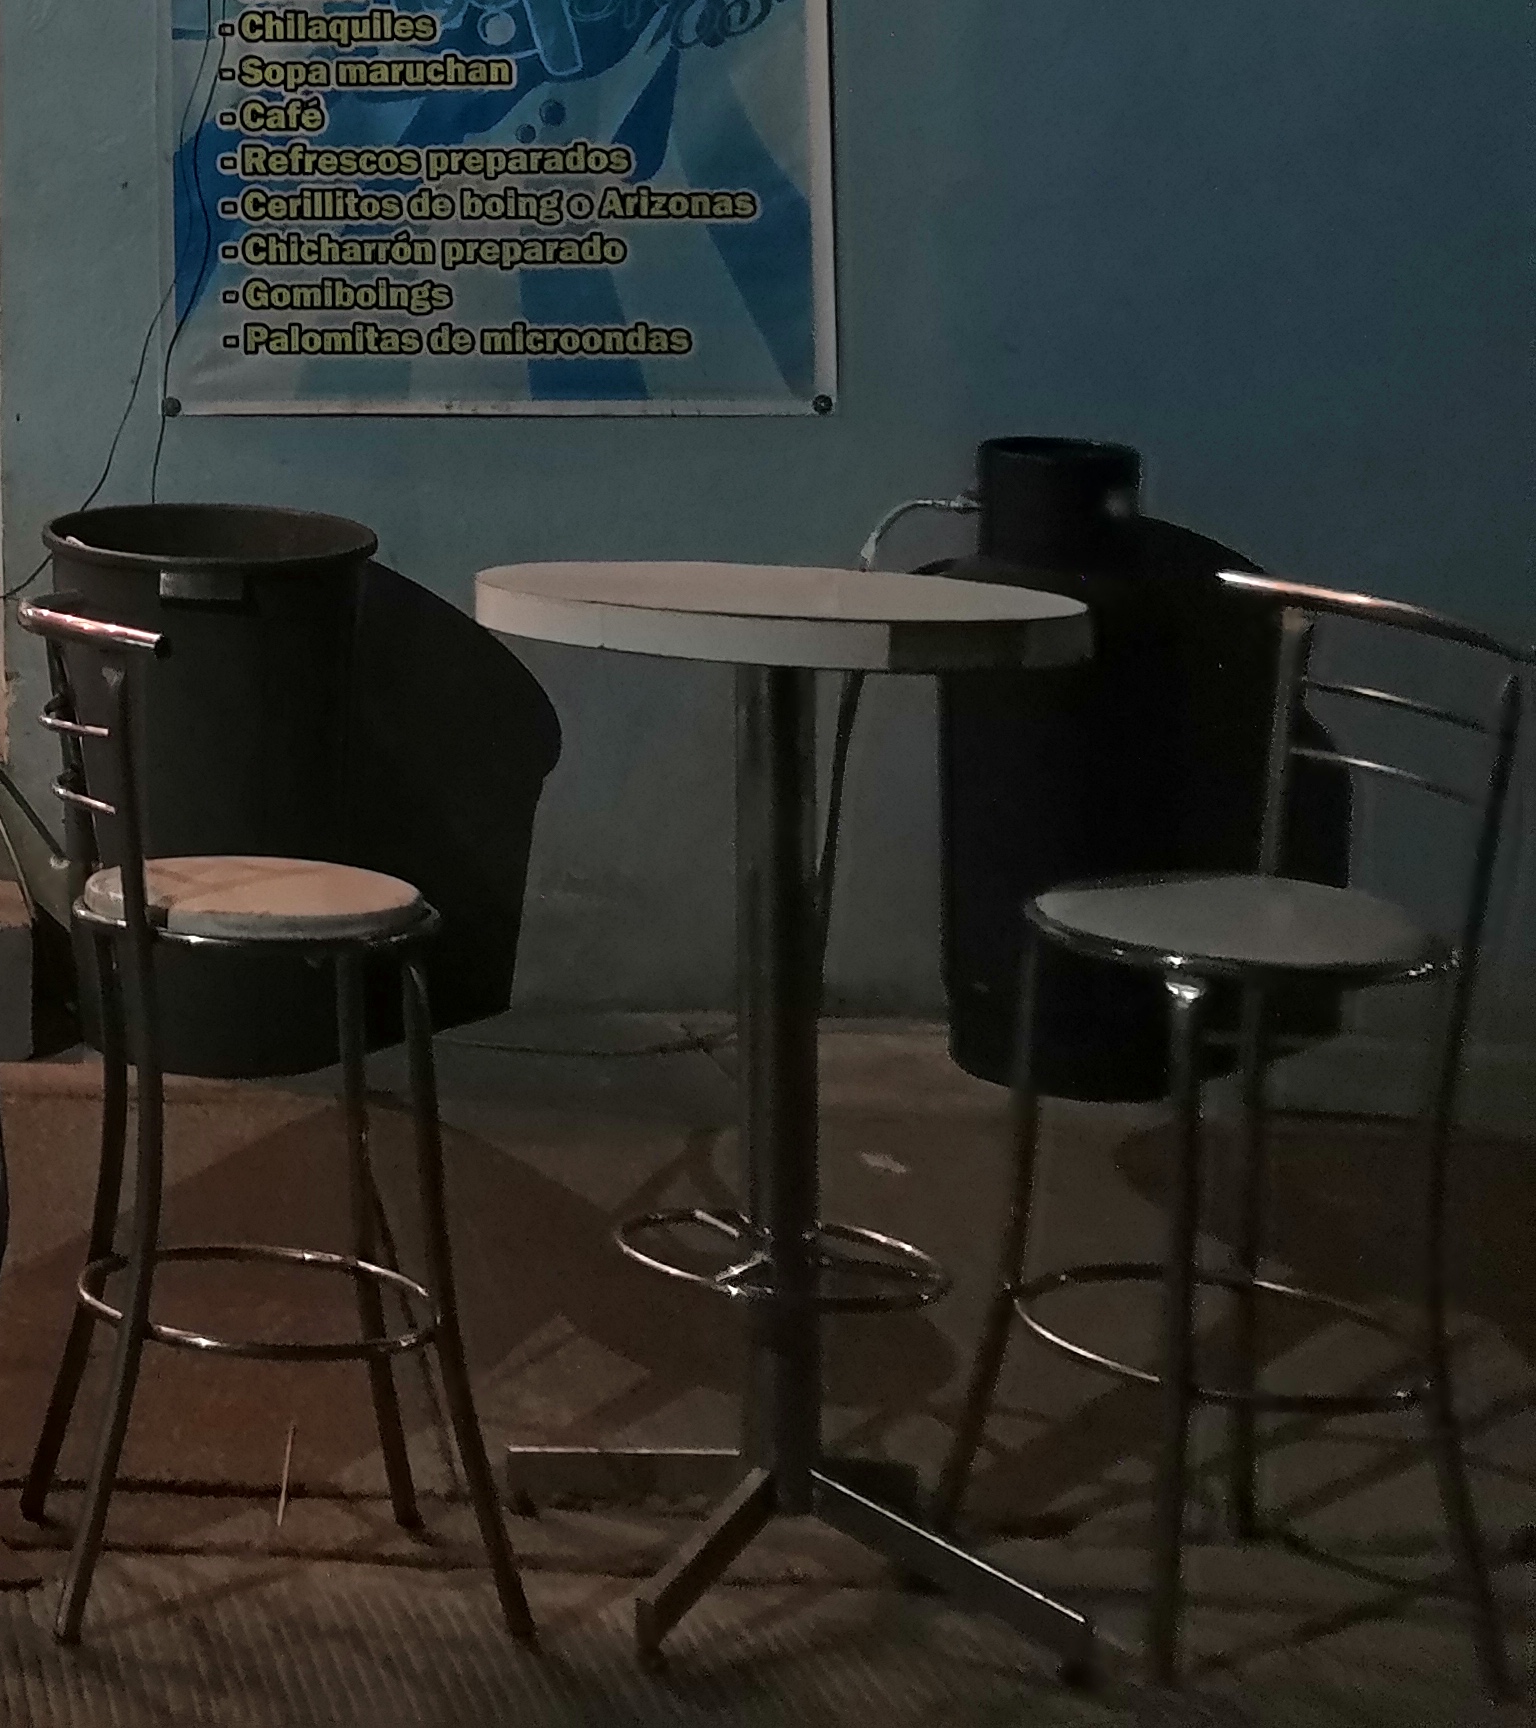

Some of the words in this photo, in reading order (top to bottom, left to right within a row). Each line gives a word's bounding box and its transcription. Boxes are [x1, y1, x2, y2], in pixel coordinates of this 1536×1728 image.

[238, 9, 438, 48] Chilaquiles
[238, 55, 330, 92] Sopa
[335, 53, 515, 88] maruchan
[239, 97, 326, 133] Café
[240, 143, 424, 178] Refrescos
[426, 141, 634, 181] preparados
[240, 187, 404, 222] Cerillitos
[408, 187, 457, 221] de
[460, 185, 565, 226] boing
[566, 193, 597, 219] o
[597, 184, 759, 221] Arizonas
[241, 230, 437, 267] Chicharrón
[440, 233, 629, 271] preparado
[241, 276, 454, 316] Gomiboings
[242, 322, 424, 357] Palomitas
[428, 322, 479, 356] de
[479, 322, 695, 356] microondas
